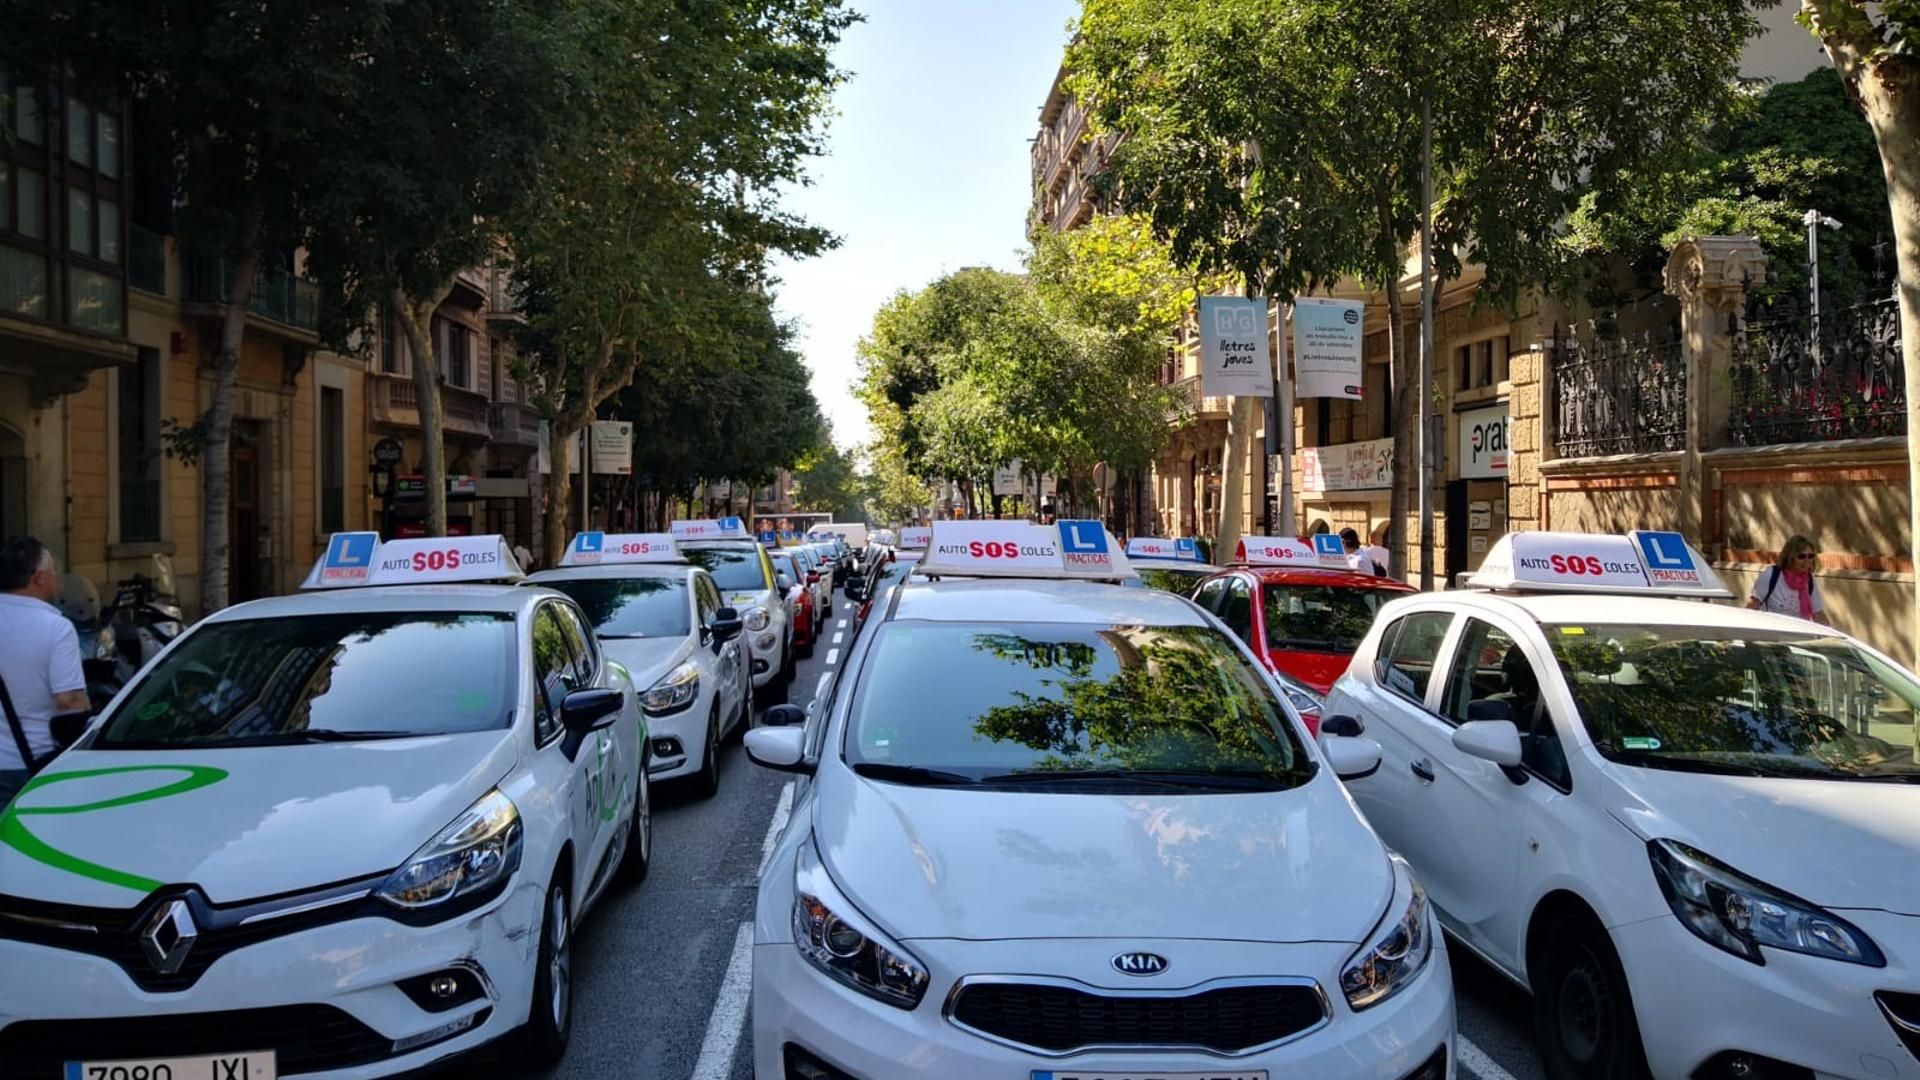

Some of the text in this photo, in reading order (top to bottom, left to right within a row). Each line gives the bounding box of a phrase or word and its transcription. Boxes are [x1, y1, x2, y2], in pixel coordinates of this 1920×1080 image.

[1219, 339, 1256, 352] lletres
[1222, 353, 1254, 368] joves
[582, 535, 595, 551] L
[1071, 525, 1096, 549] L
[1322, 537, 1337, 553] L
[337, 539, 360, 563] L
[621, 543, 649, 555] SOS
[939, 541, 1055, 558] AUTO SOS COLES
[1264, 547, 1293, 558] SOS
[1650, 538, 1681, 564] L
[382, 549, 496, 572] AUTO SOS COLES
[1520, 554, 1641, 576] AUTO SOS COLES
[1121, 955, 1162, 970] KIA
